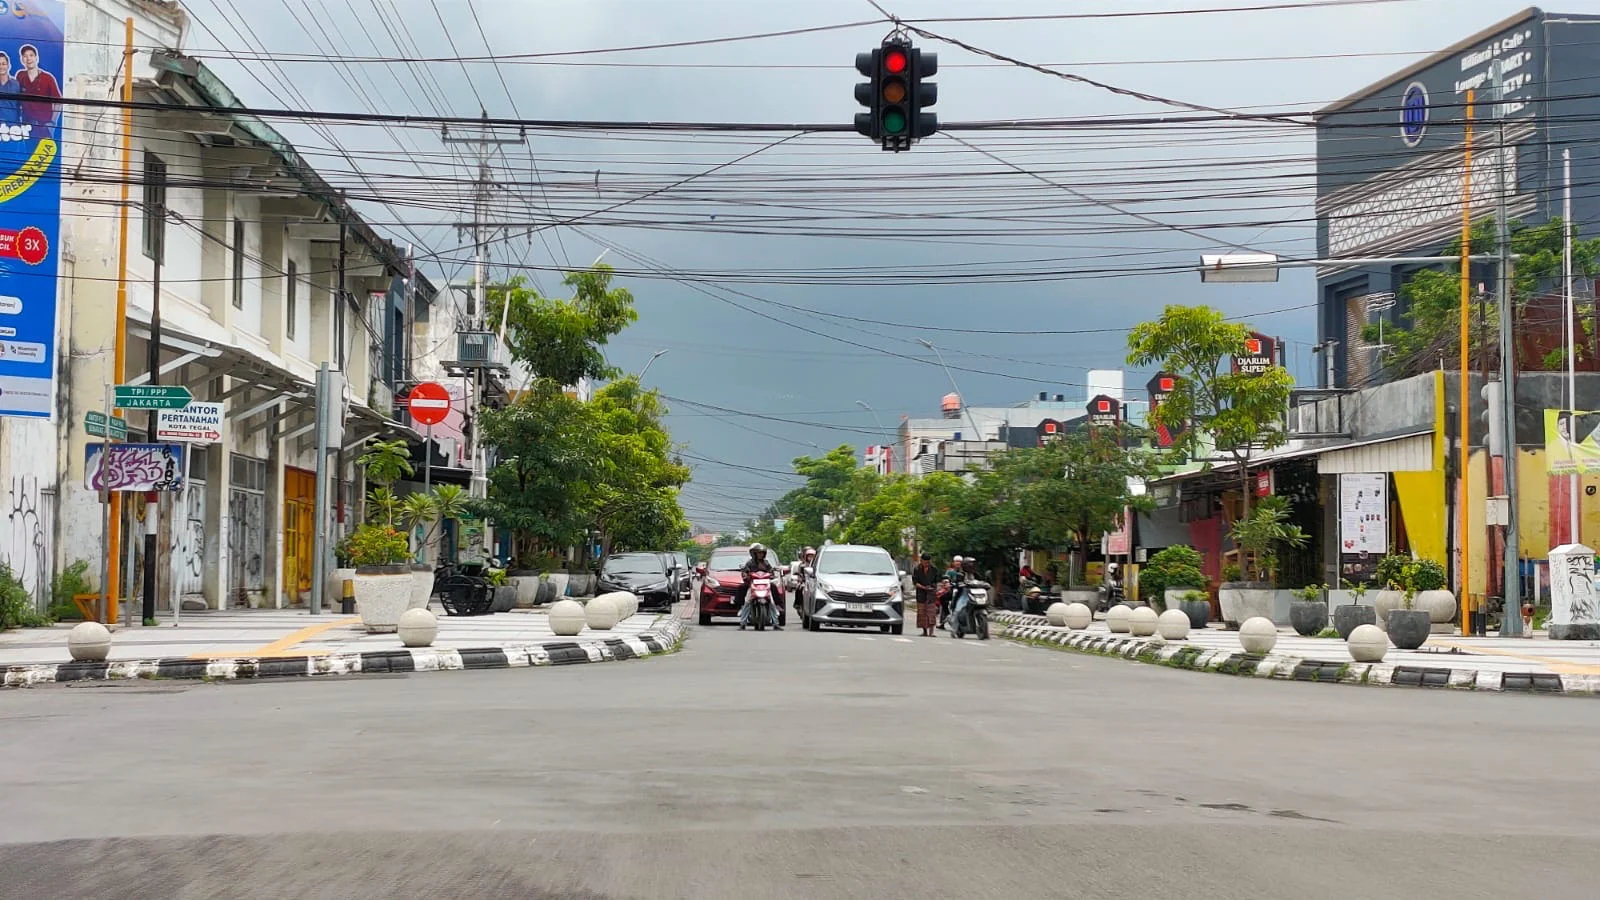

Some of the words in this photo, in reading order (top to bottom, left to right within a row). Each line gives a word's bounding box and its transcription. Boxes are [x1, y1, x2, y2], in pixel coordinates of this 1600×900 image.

[1502, 32, 1524, 52] Cafe
[0, 122, 32, 142] ter
[24, 238, 40, 251] 3X
[131, 388, 145, 396] TPI
[150, 388, 167, 396] PPP
[126, 399, 171, 407] JAKARTA
[161, 414, 219, 425] PERTANAHAN
